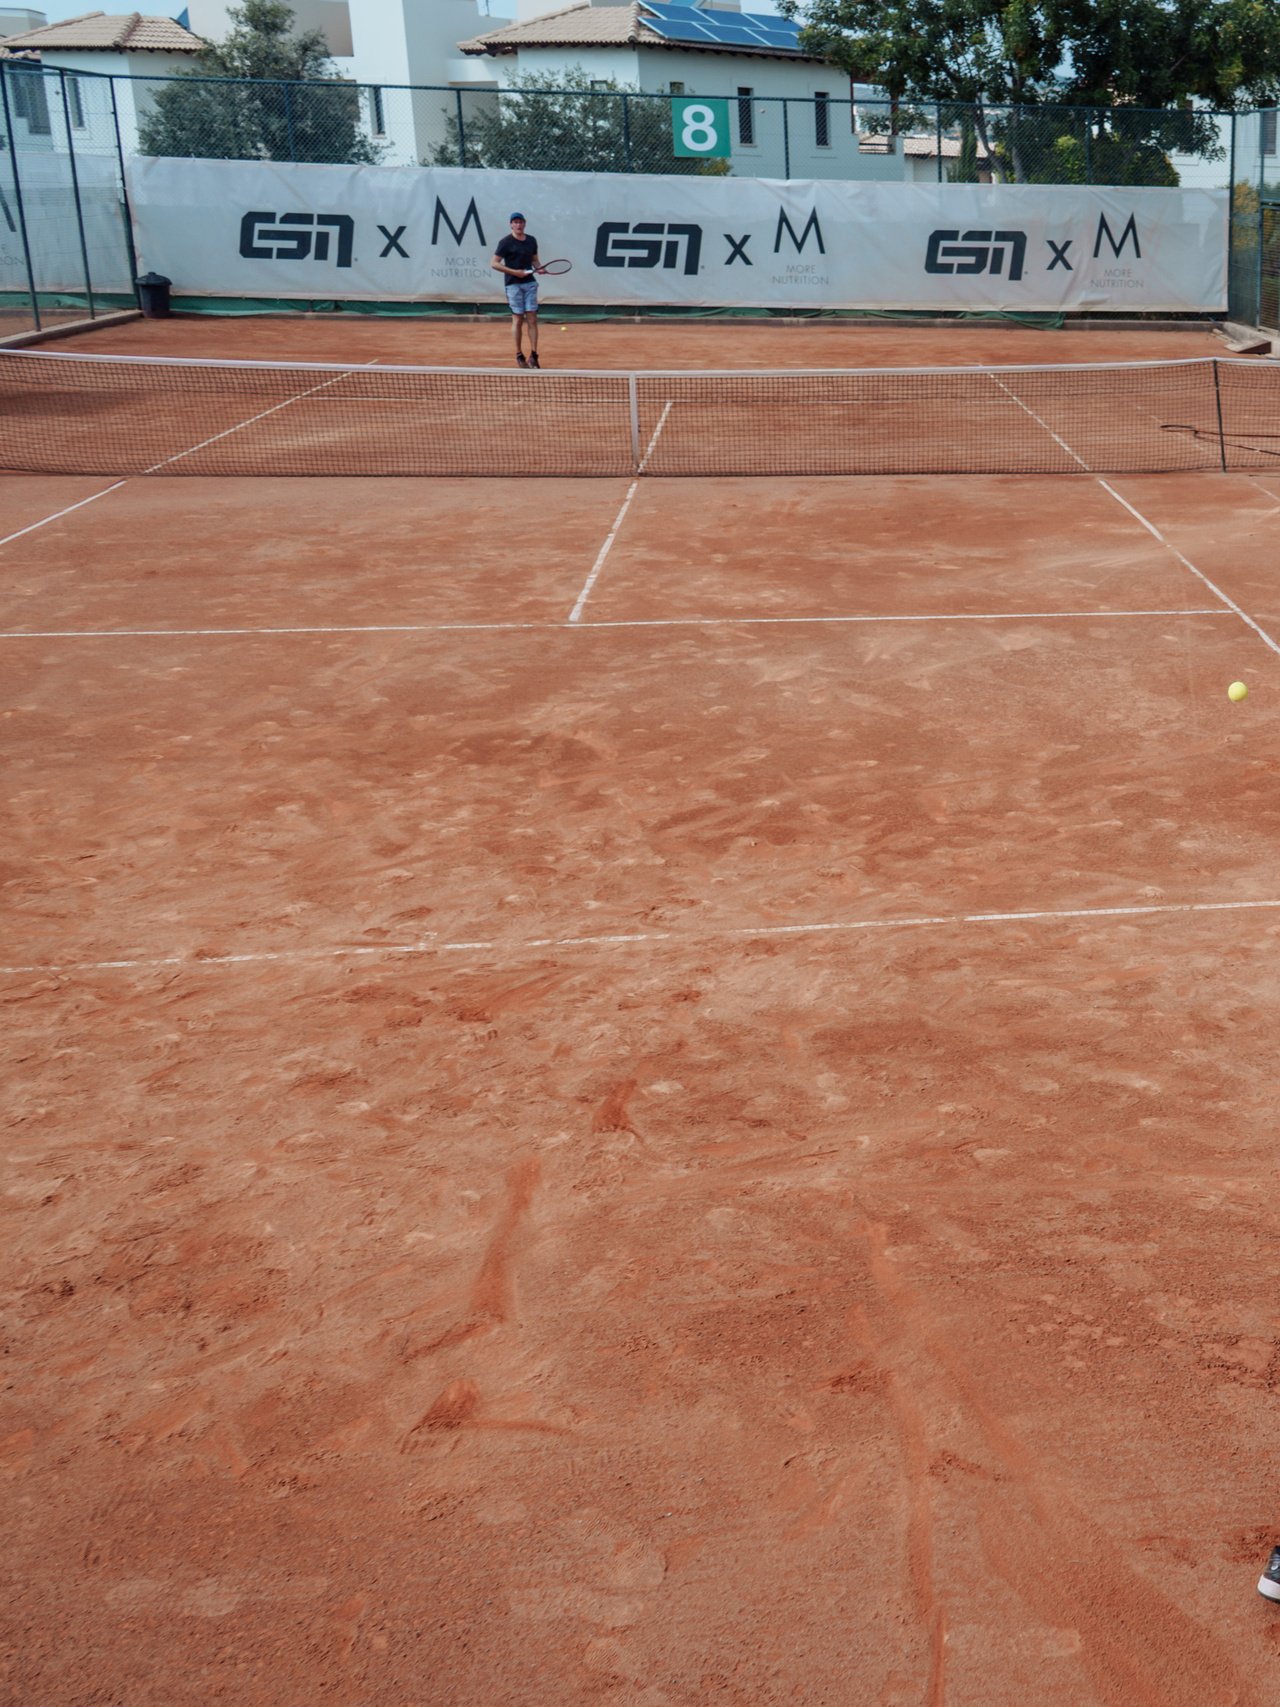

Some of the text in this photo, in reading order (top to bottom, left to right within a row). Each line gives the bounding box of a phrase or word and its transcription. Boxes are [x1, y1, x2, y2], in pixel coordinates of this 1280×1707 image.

[682, 104, 718, 152] 8
[431, 195, 487, 247] M
[773, 204, 826, 255] M
[1093, 211, 1142, 259] M
[445, 257, 478, 267] MORE
[431, 268, 492, 279] NUTRITION
[786, 264, 816, 274] MORE
[1103, 268, 1132, 278] MORE
[772, 275, 829, 285] NUTRITION
[1090, 279, 1144, 288] NUTRITION
